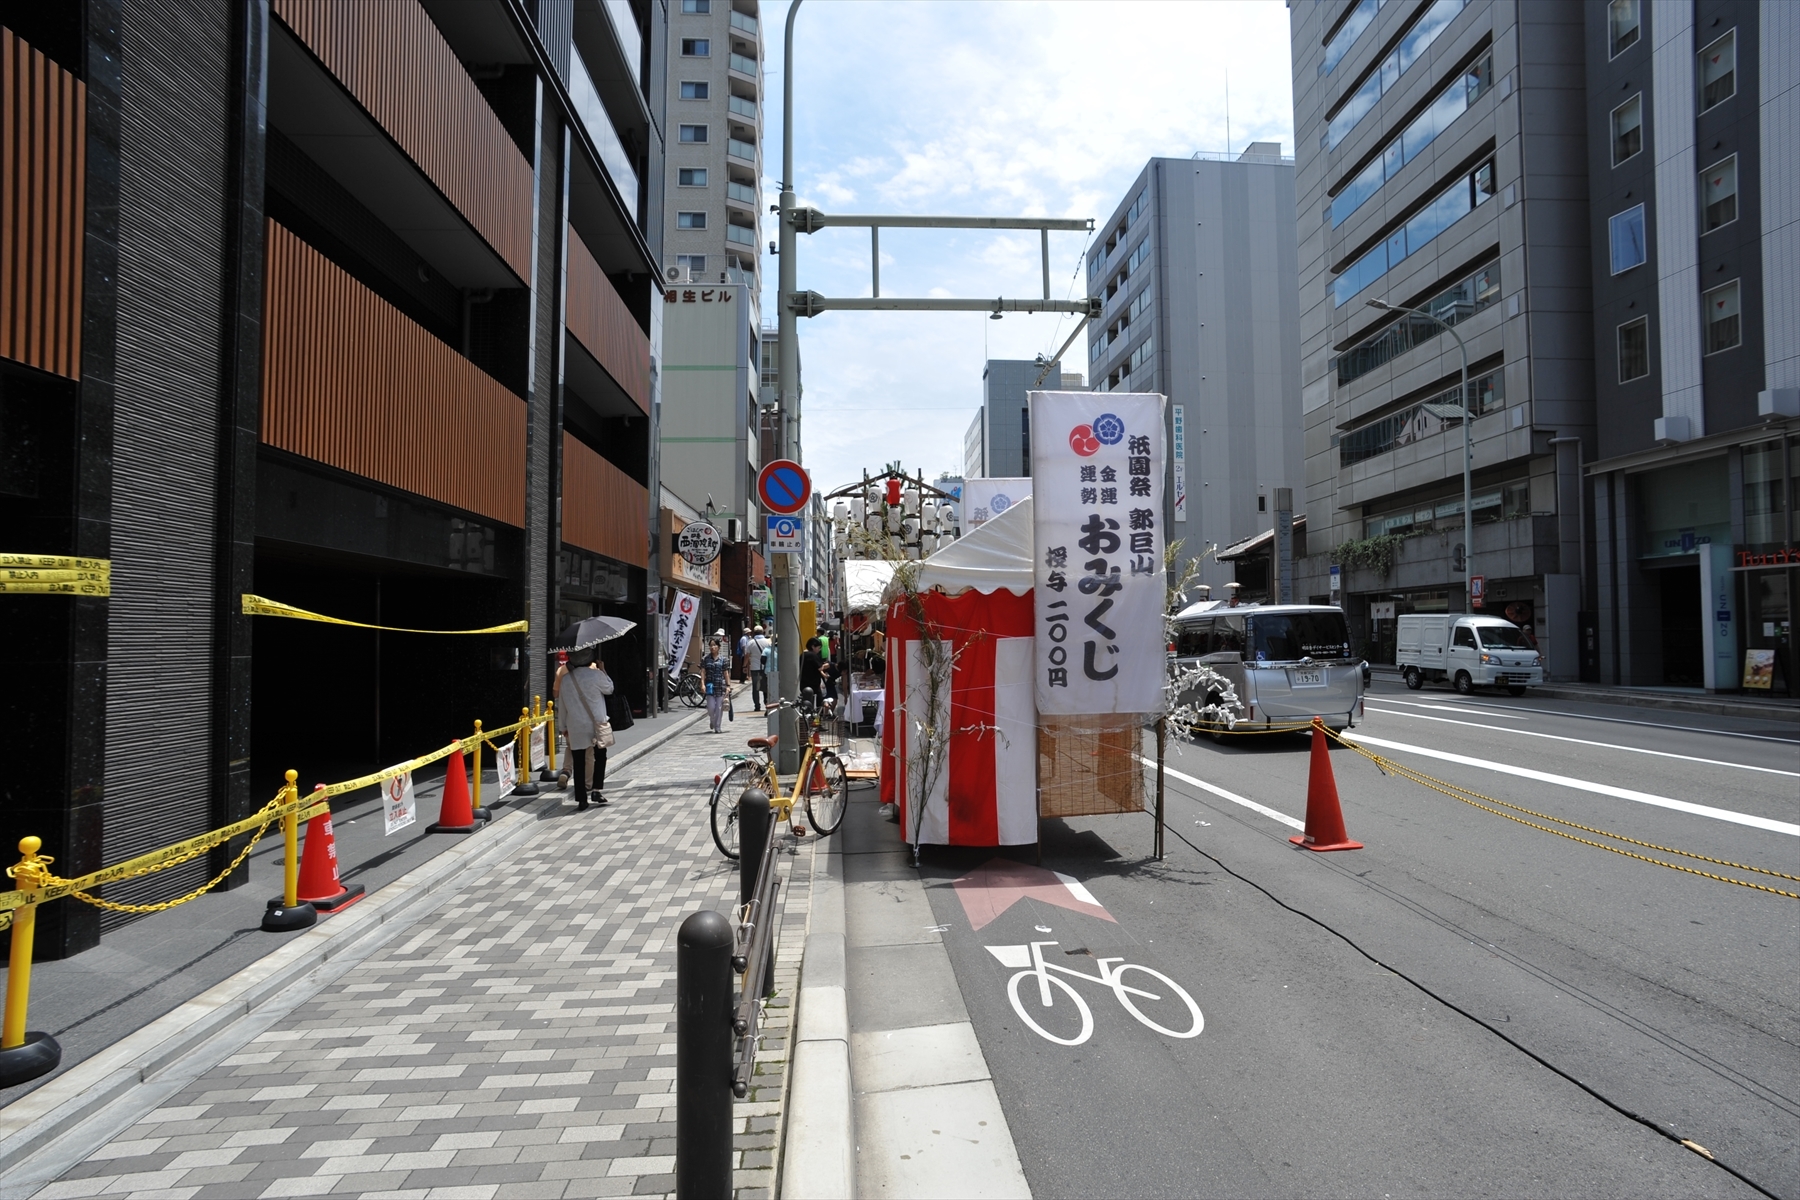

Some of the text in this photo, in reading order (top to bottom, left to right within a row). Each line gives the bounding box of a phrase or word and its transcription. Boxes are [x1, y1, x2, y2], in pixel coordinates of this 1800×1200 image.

[1174, 408, 1183, 459] 平野歯科医院
[1080, 465, 1098, 505] 運勢
[1100, 465, 1118, 505] 金運
[1128, 435, 1155, 577] 祇園祭 郭巨山
[1664, 534, 1711, 550] UNIZO
[1046, 546, 1069, 593] 授与
[1078, 513, 1123, 681] おみくじ
[1717, 594, 1730, 637] UNIZO
[44, 884, 68, 900] KEEP
[71, 878, 87, 892] OUT
[191, 838, 206, 848] KEEP
[205, 833, 217, 844] OUT
